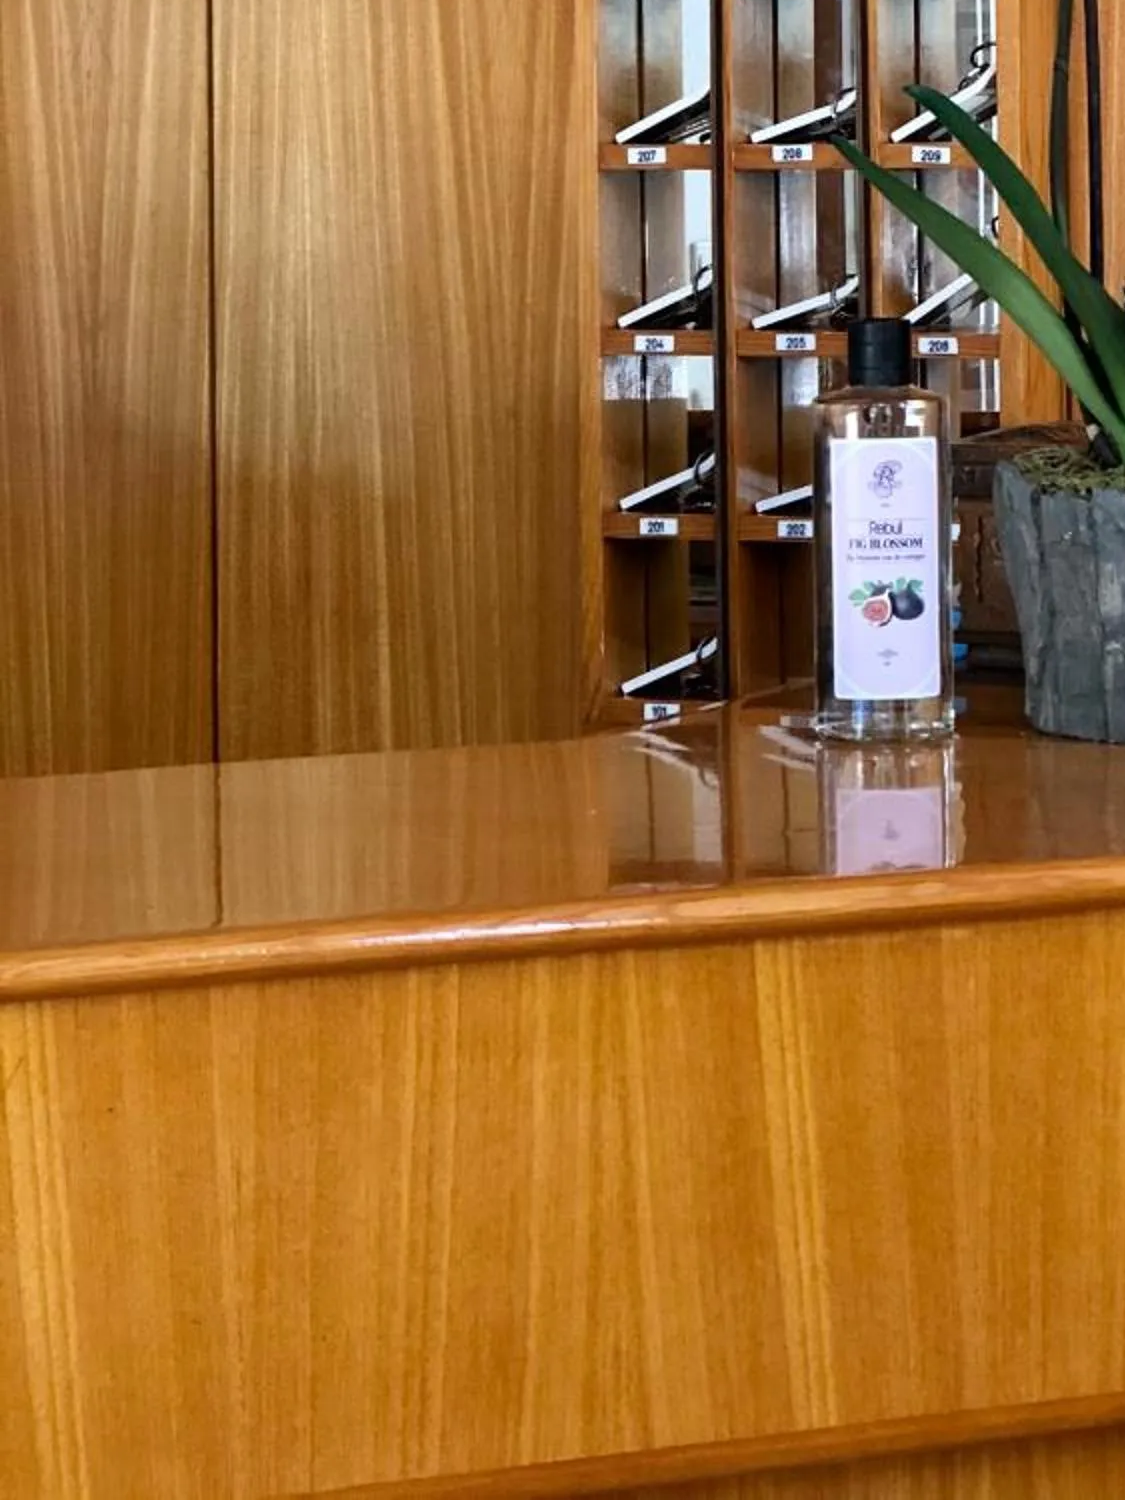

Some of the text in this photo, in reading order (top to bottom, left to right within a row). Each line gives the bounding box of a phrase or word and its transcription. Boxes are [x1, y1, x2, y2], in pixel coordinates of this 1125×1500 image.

[638, 149, 657, 162] 207
[644, 338, 665, 351] 204
[647, 521, 665, 533] 201
[869, 519, 902, 535] Rebul
[870, 537, 923, 549] BLOSSOM
